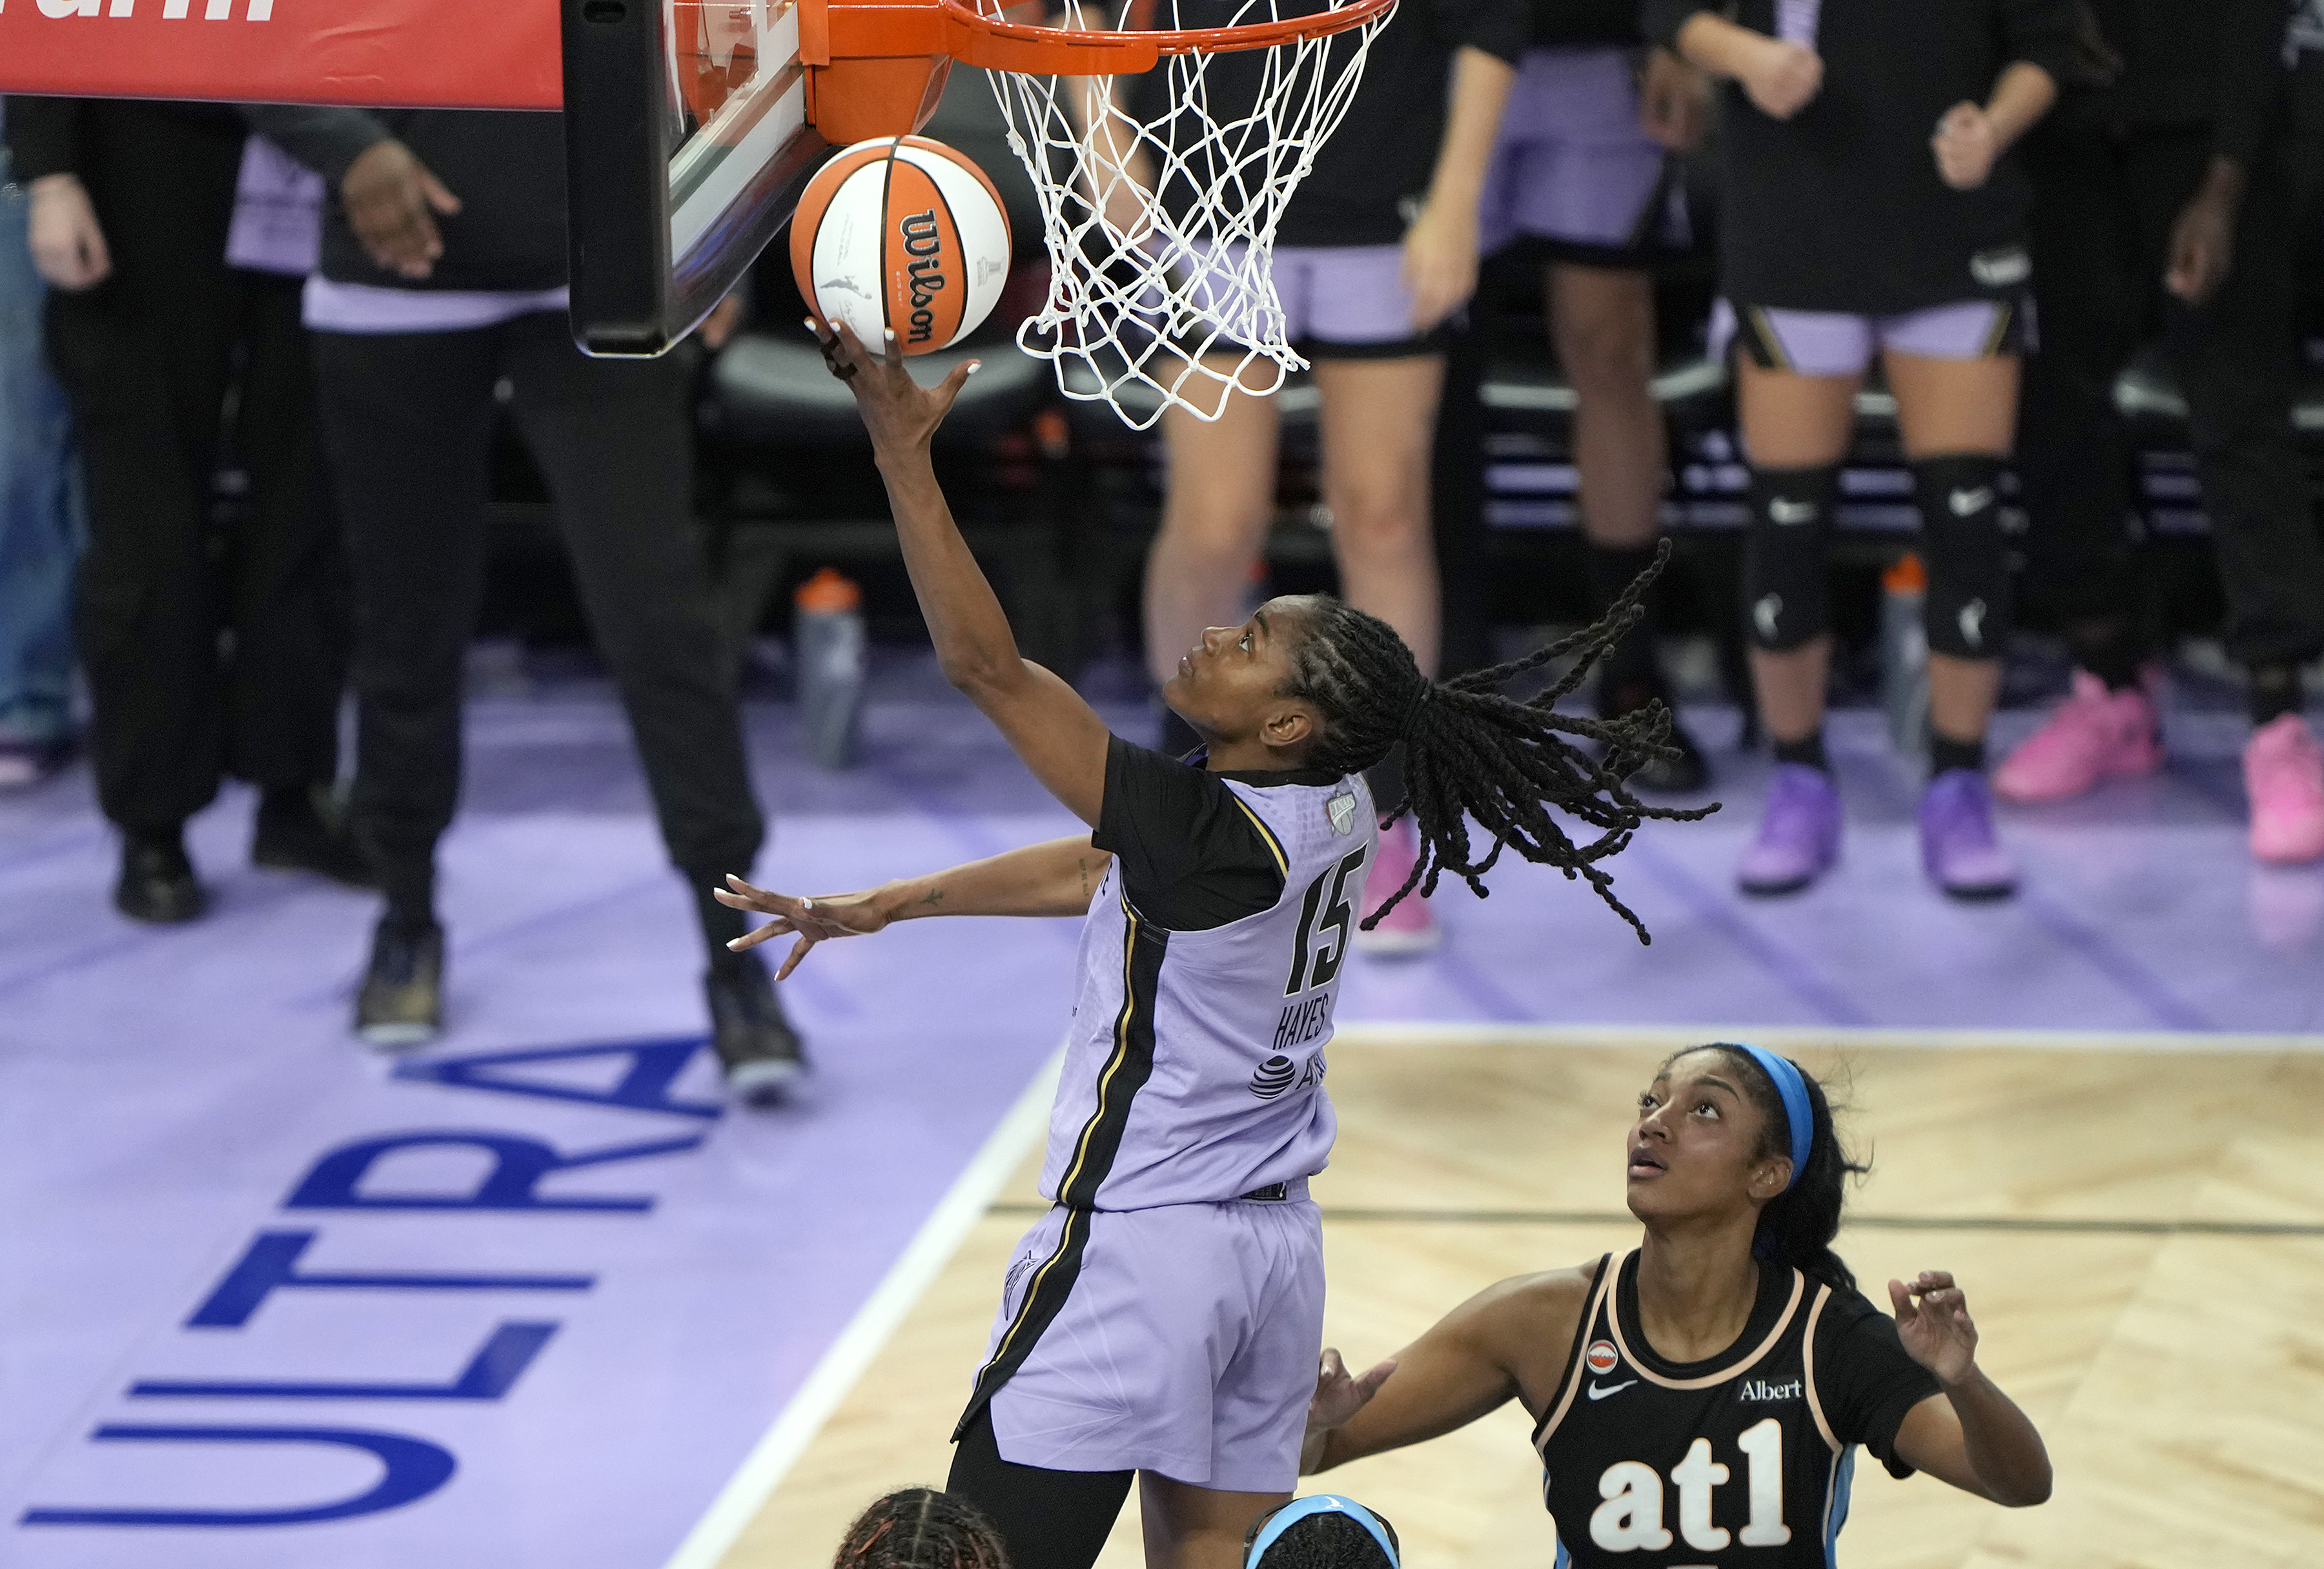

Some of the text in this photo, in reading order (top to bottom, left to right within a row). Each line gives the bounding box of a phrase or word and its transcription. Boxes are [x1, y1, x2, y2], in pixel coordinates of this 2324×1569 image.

[900, 208, 946, 344] Wilson
[1283, 839, 1370, 999] 15
[1272, 992, 1329, 1051] HAYES
[17, 1034, 726, 1529] ULTRA
[1739, 1379, 1802, 1400] Albert
